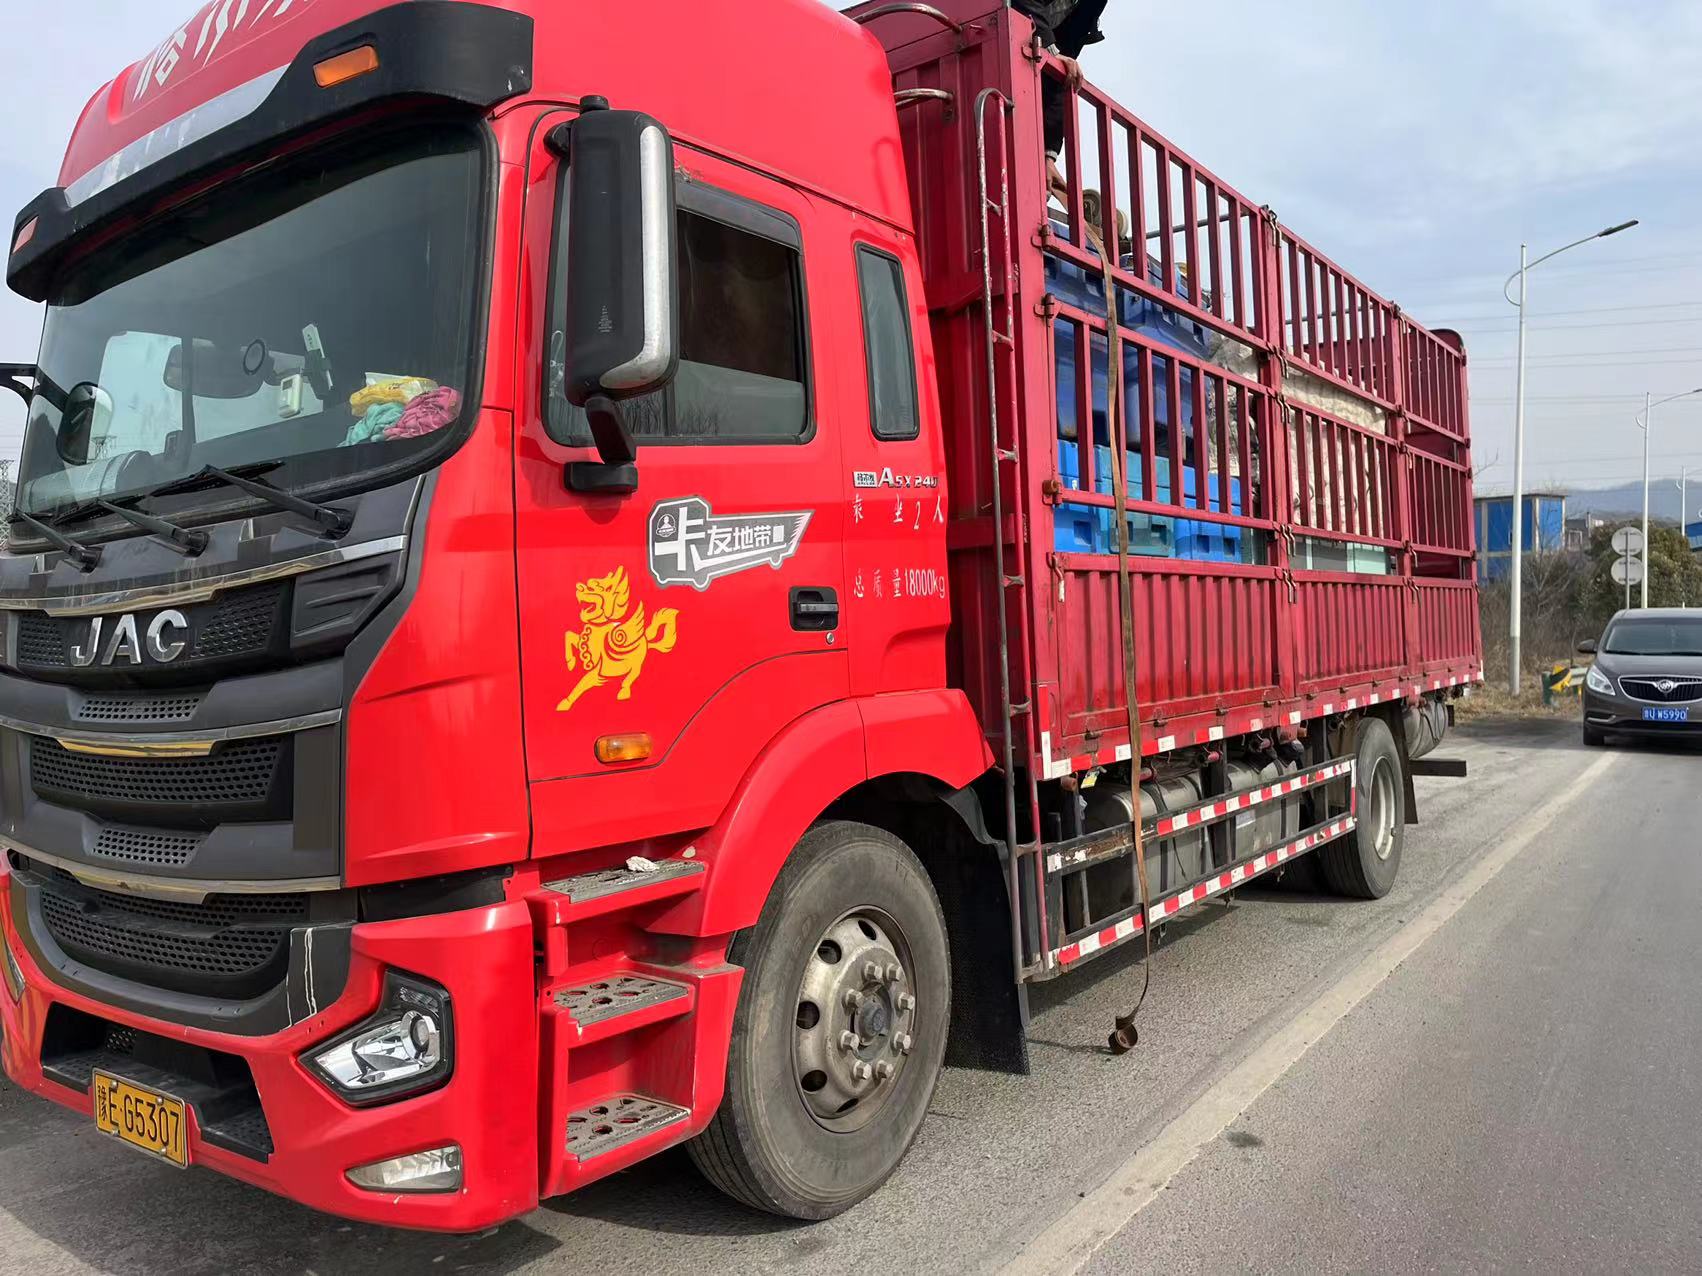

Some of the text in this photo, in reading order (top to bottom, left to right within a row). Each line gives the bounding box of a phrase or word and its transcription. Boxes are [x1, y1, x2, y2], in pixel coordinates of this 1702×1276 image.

[655, 507, 787, 572] 卡友地带
[70, 609, 188, 667] JAC
